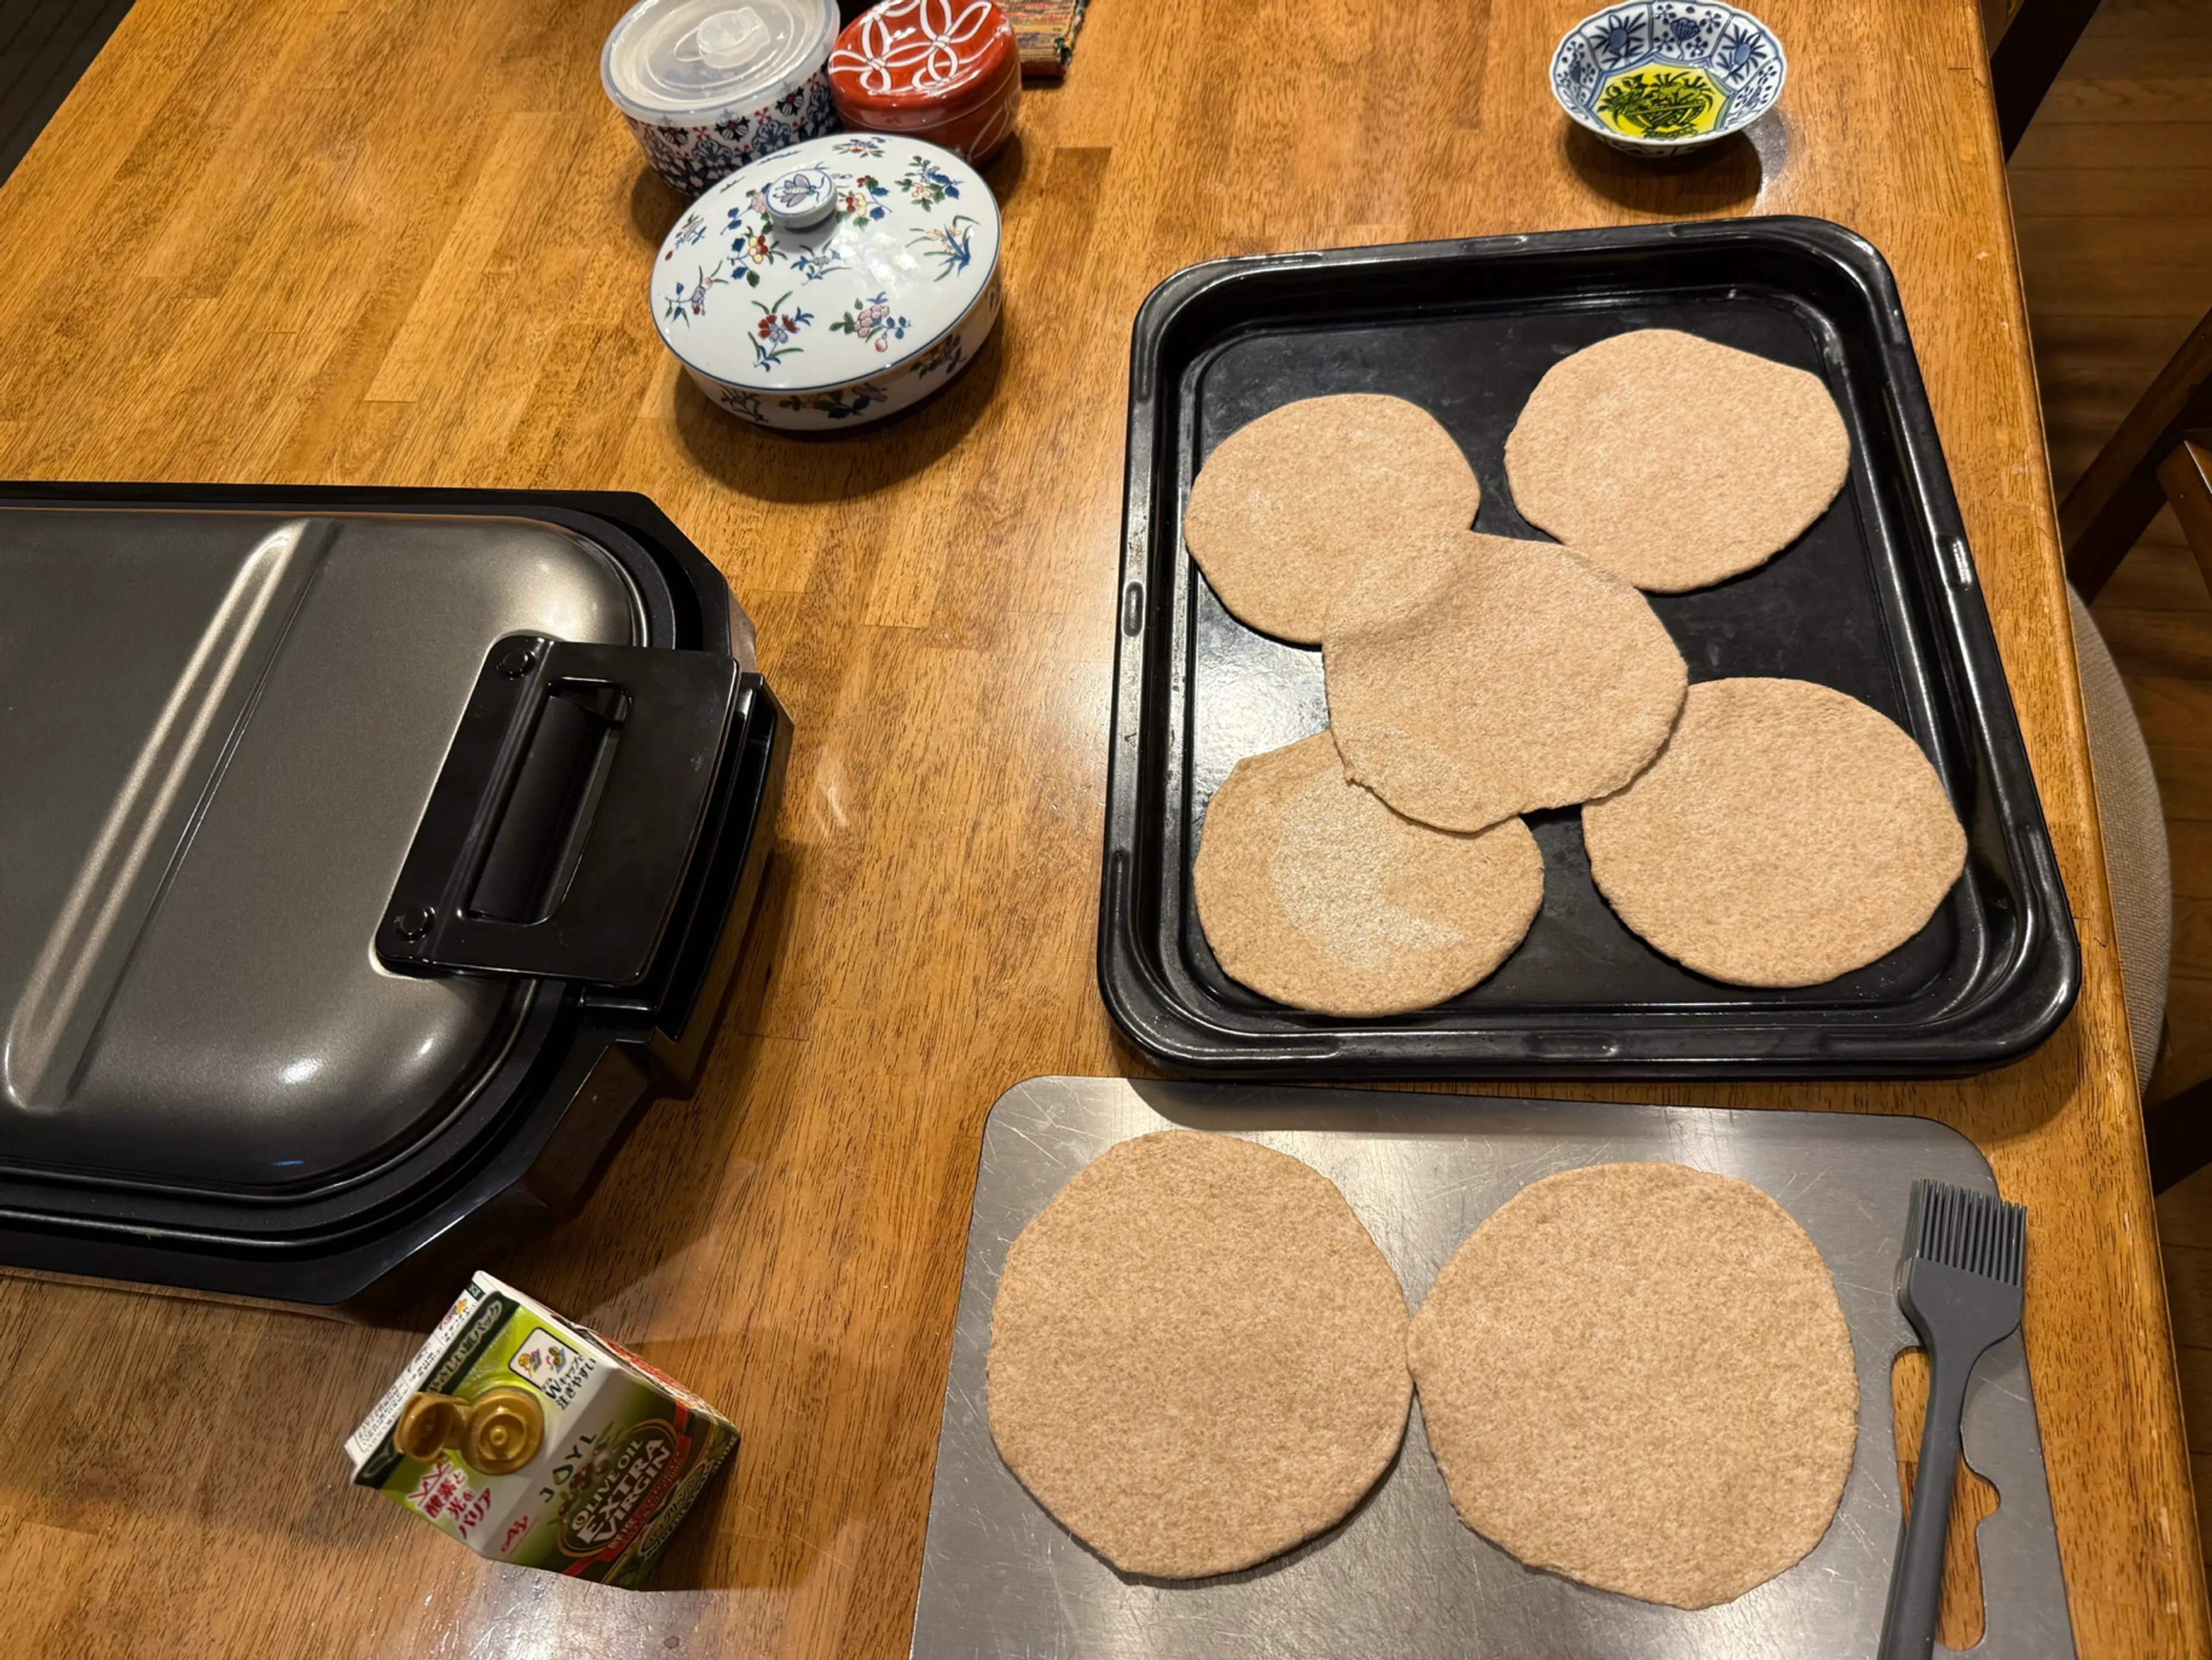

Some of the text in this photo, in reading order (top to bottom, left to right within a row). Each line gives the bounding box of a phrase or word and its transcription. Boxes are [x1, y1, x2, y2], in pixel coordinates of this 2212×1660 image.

[556, 1358, 596, 1411] 注ぎやすい
[424, 1470, 465, 1518] 酸素と
[539, 1434, 597, 1503] JOYL
[572, 1440, 643, 1530] OLIVE OIL
[577, 1439, 664, 1544] EXTRA
[593, 1446, 671, 1541] VIRGIN
[446, 1489, 475, 1521] 光を
[459, 1487, 491, 1540] バリア
